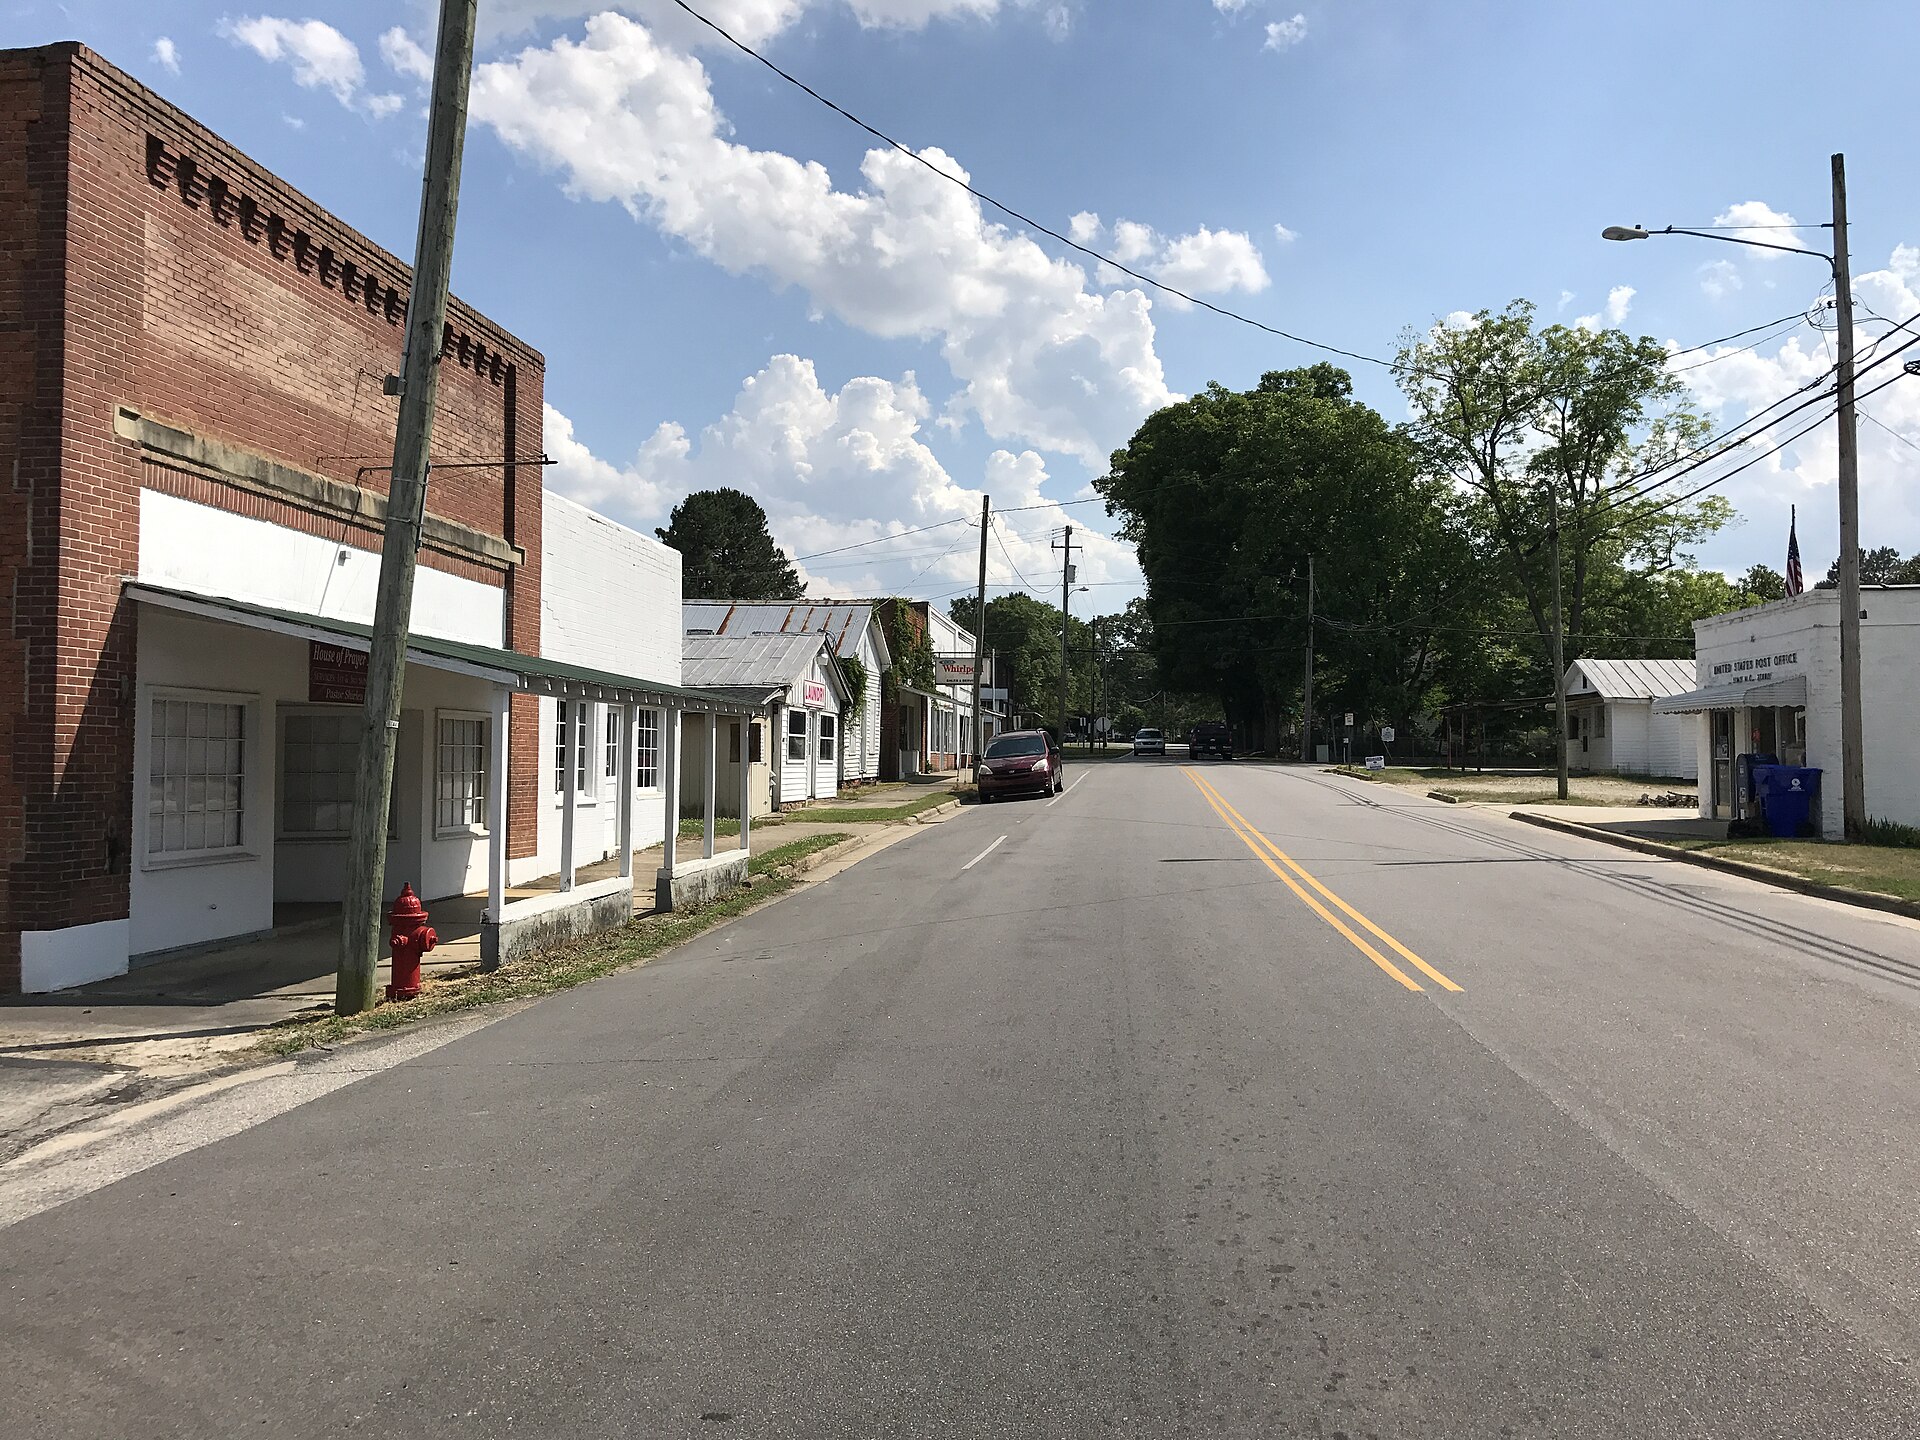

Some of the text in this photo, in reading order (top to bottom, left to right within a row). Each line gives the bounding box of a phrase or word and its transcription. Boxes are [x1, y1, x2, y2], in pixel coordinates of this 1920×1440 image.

[313, 644, 367, 669] House of Prayer
[1713, 652, 1798, 675] UNITED STATES POST OFFICE
[325, 687, 344, 700] Pastor
